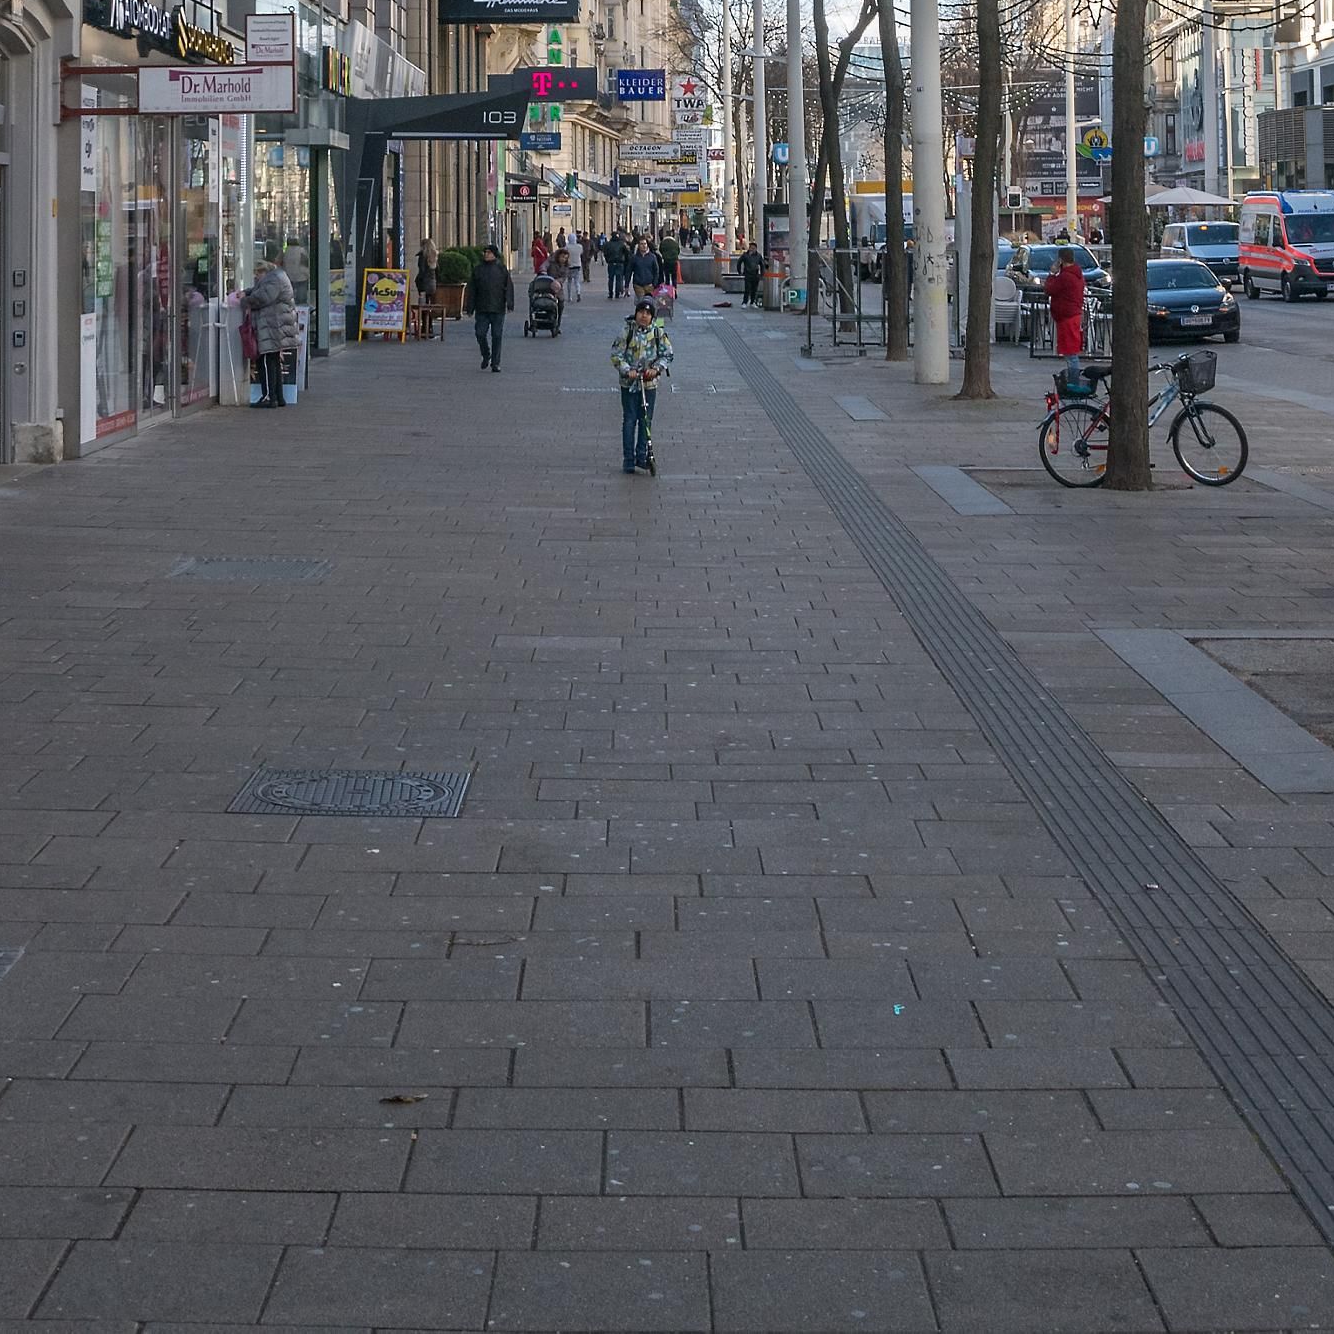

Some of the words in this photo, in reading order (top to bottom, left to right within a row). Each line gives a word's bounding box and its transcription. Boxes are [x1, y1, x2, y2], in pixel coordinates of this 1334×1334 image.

[203, 76, 251, 94] Marhold
[619, 79, 664, 87] KLEIDER
[619, 87, 664, 95] BAUER
[181, 95, 224, 103] Immobilien
[227, 95, 251, 103] GmbH
[674, 99, 705, 109] TWA
[483, 110, 517, 124] 103
